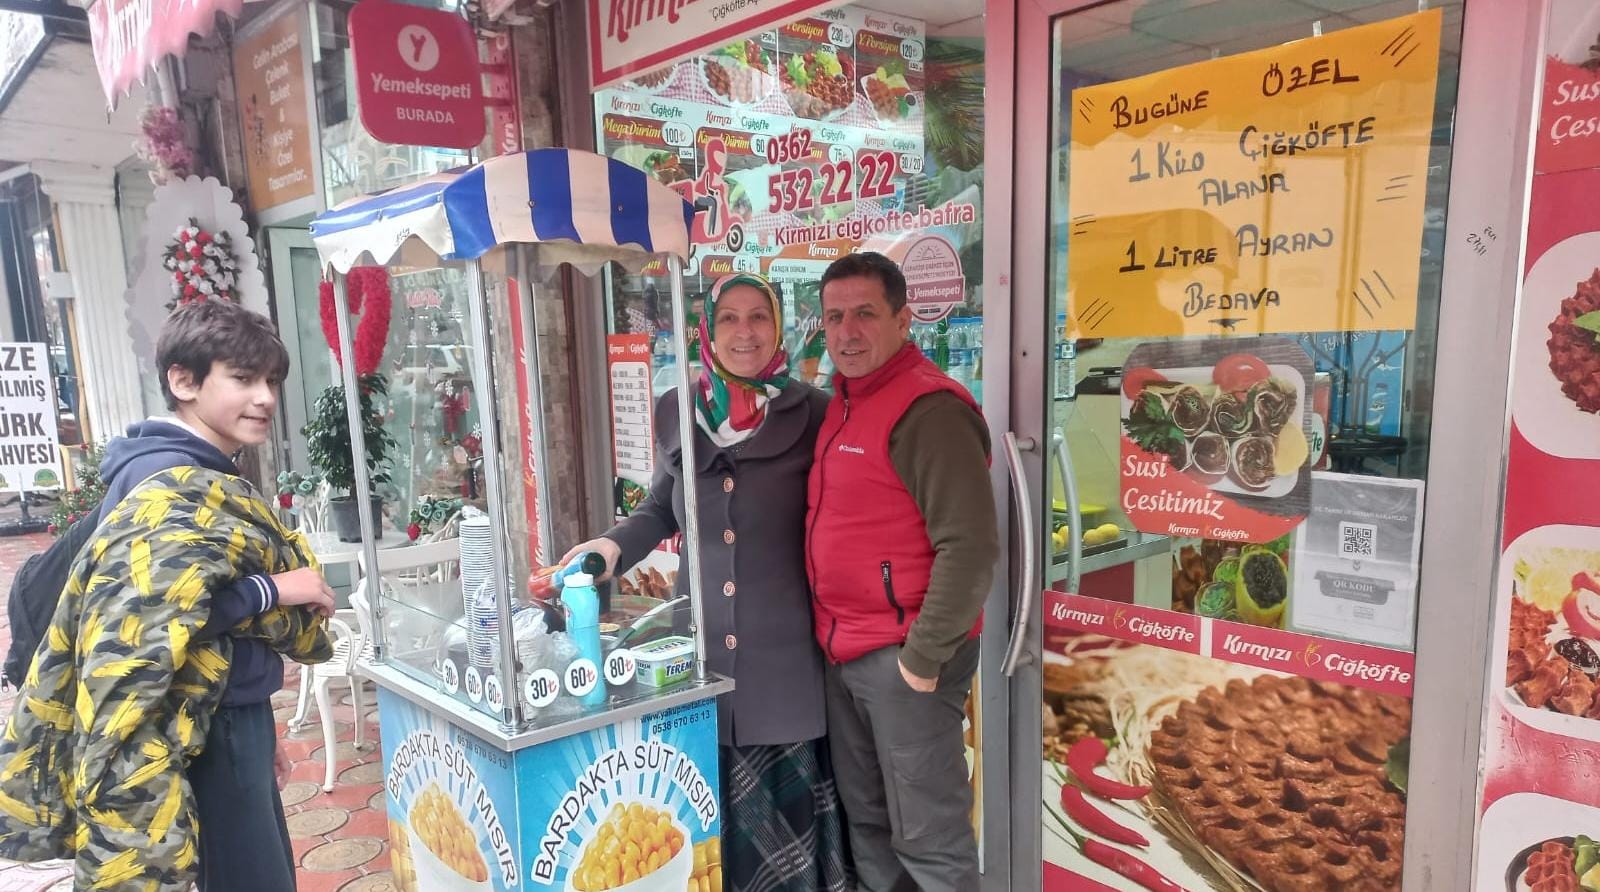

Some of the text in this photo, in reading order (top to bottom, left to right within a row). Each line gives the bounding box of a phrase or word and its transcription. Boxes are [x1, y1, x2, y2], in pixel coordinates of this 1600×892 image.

[371, 72, 472, 100] Yemeksepeti
[1110, 58, 1360, 129] BUGÜNE ÖZEL
[396, 106, 455, 124] BURADA
[603, 117, 661, 139] Mega Dürüm
[767, 128, 812, 164] 0362
[1128, 148, 1151, 183] 1
[768, 152, 895, 214] 532 22 22
[1198, 173, 1291, 207] ALANA
[775, 202, 975, 246] Kirmizi cigkofte.bafra
[1119, 240, 1146, 273] 1
[1235, 223, 1334, 258] AYRAN
[710, 259, 731, 272] Kutu
[1183, 281, 1281, 318] BEDAVA
[0, 346, 37, 372] ZE
[0, 437, 55, 466] HVESİ
[1123, 487, 1225, 520] Çeşitimiz
[1168, 522, 1250, 539] Kırmızı Çiğköfte
[1052, 602, 1195, 643] Kırmızı Çiğköfte
[665, 660, 692, 676] TEREM
[1223, 634, 1411, 684] Kırmızı Çiğköfte
[652, 709, 710, 735] 0538 670 63 13
[389, 733, 515, 884] BARDAKTA SÜT MISIR
[534, 740, 716, 880] BARDAKTA SÜT MISIR
